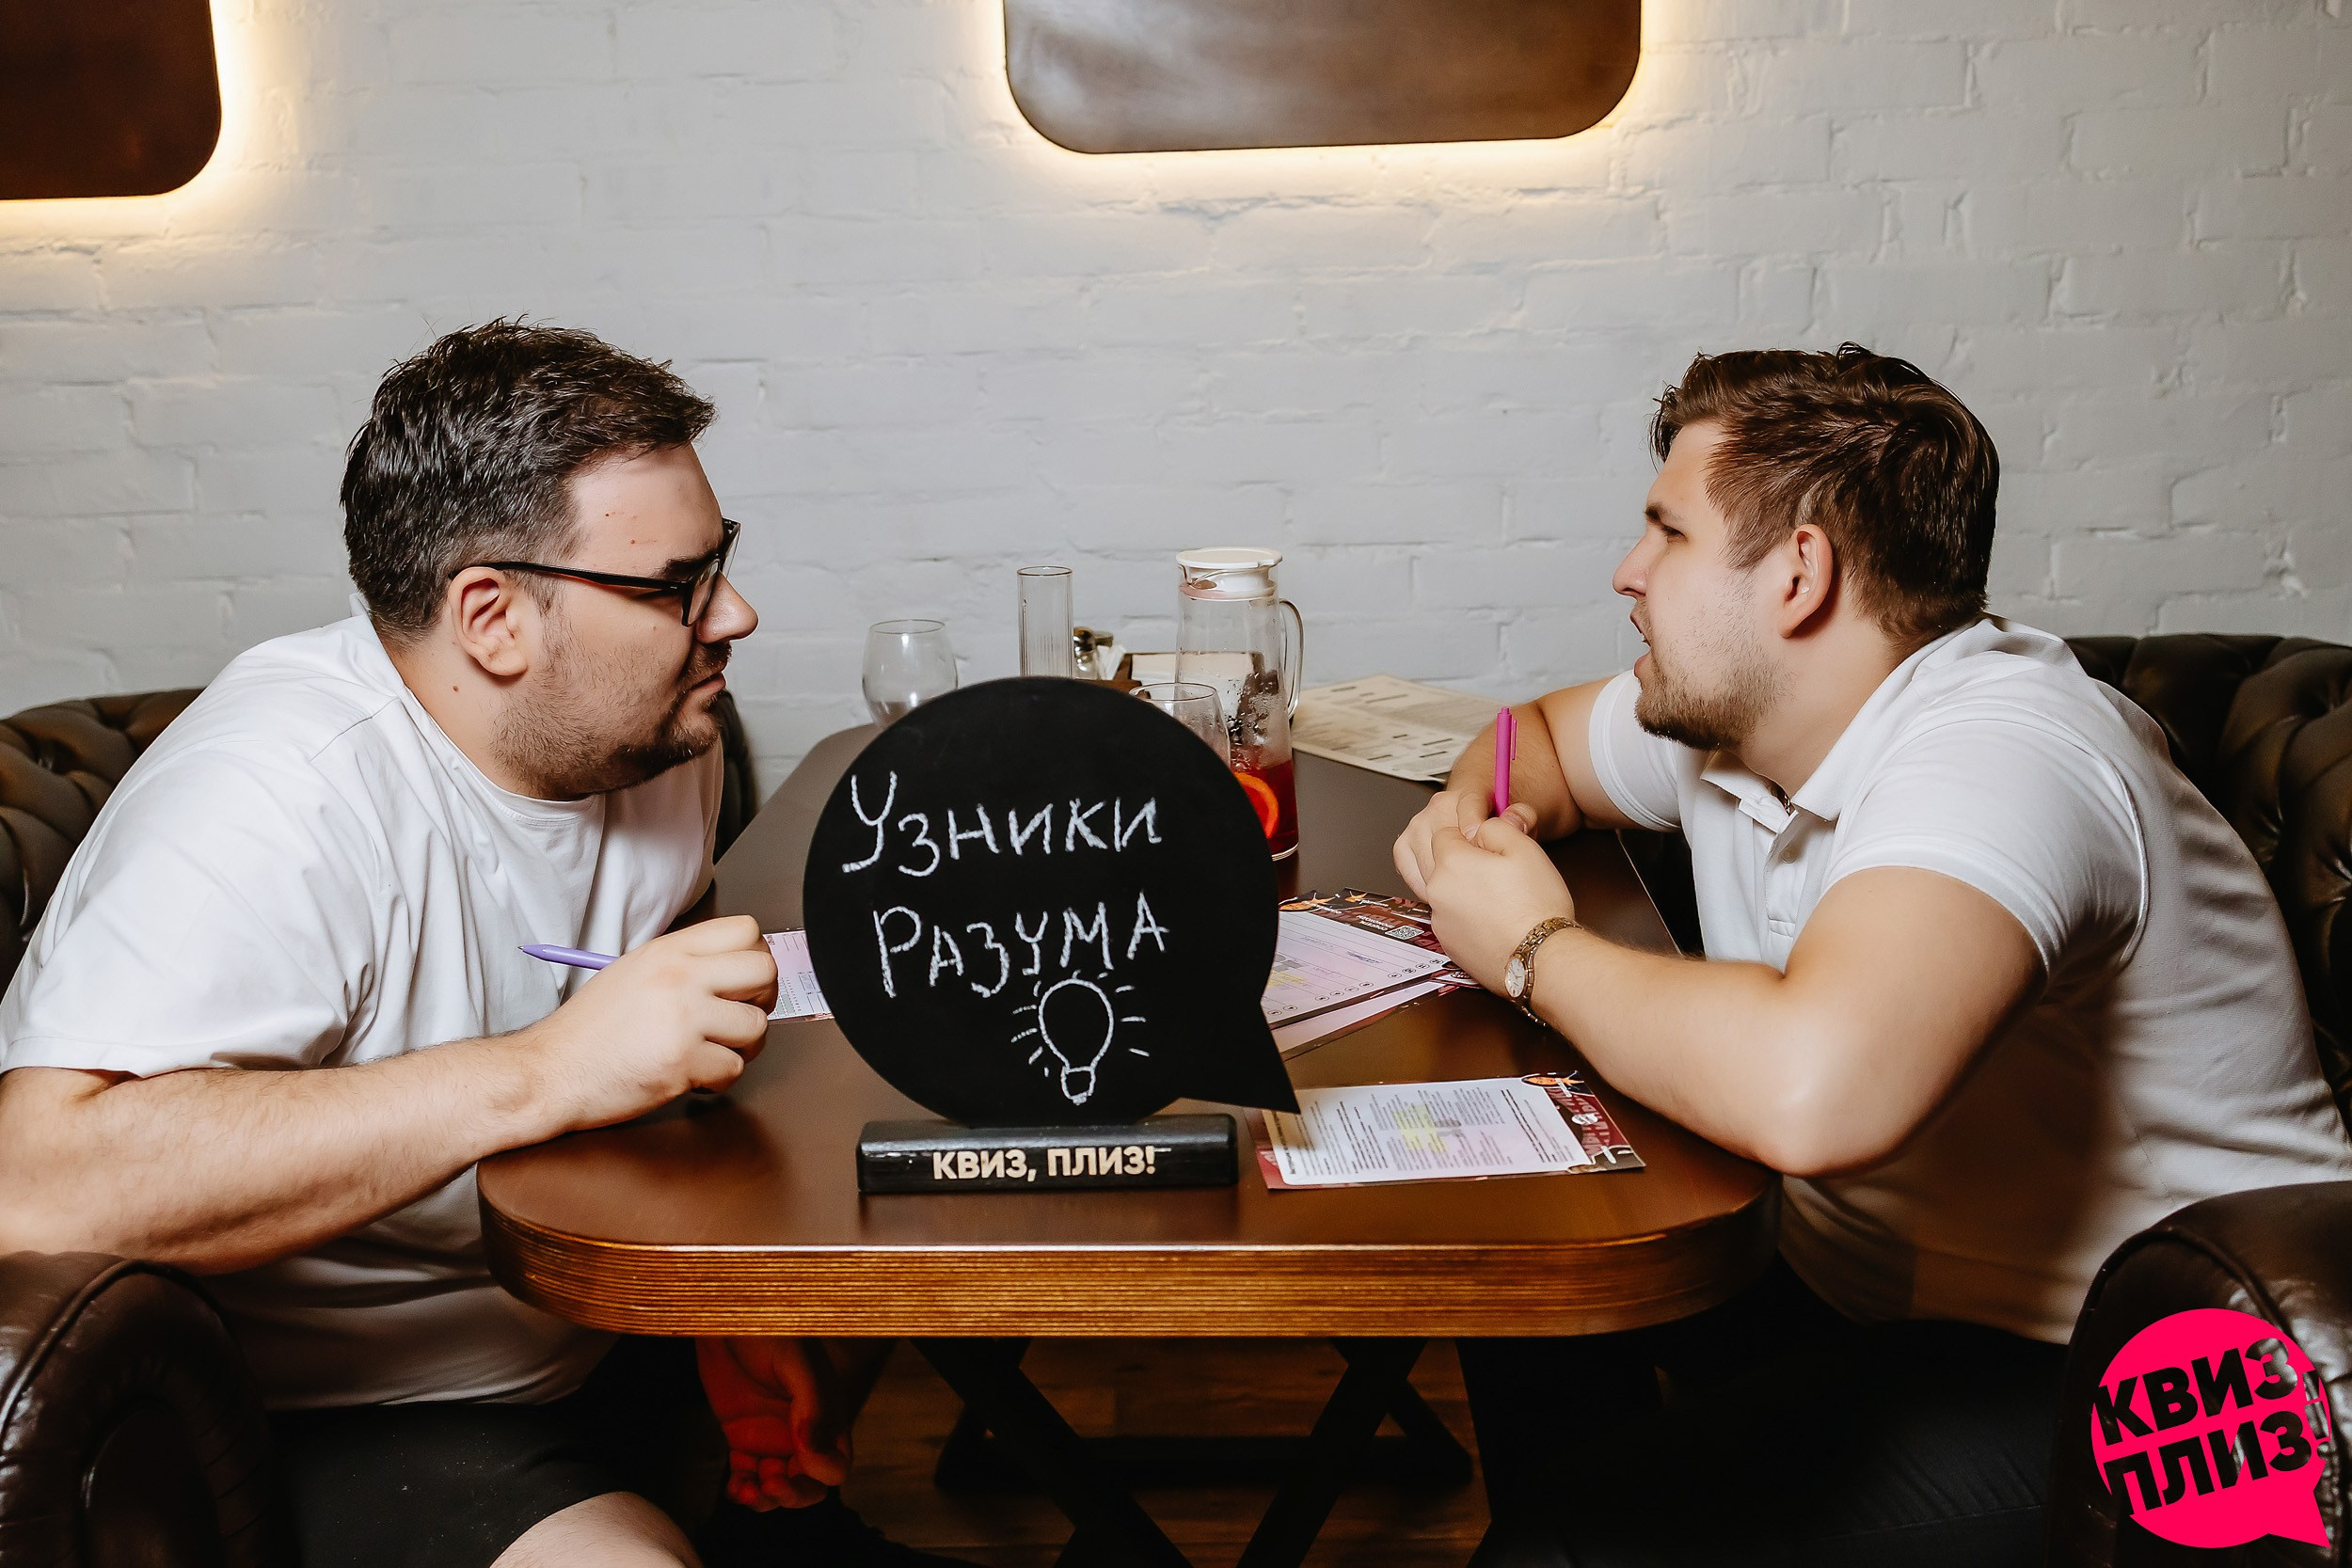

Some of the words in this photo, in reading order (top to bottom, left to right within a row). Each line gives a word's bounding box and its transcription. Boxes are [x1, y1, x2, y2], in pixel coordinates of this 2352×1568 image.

[873, 891, 1169, 998] РАЗУМА
[932, 1149, 1038, 1181] КВИЗ,
[1047, 1145, 1157, 1177] ПЛИЗ!
